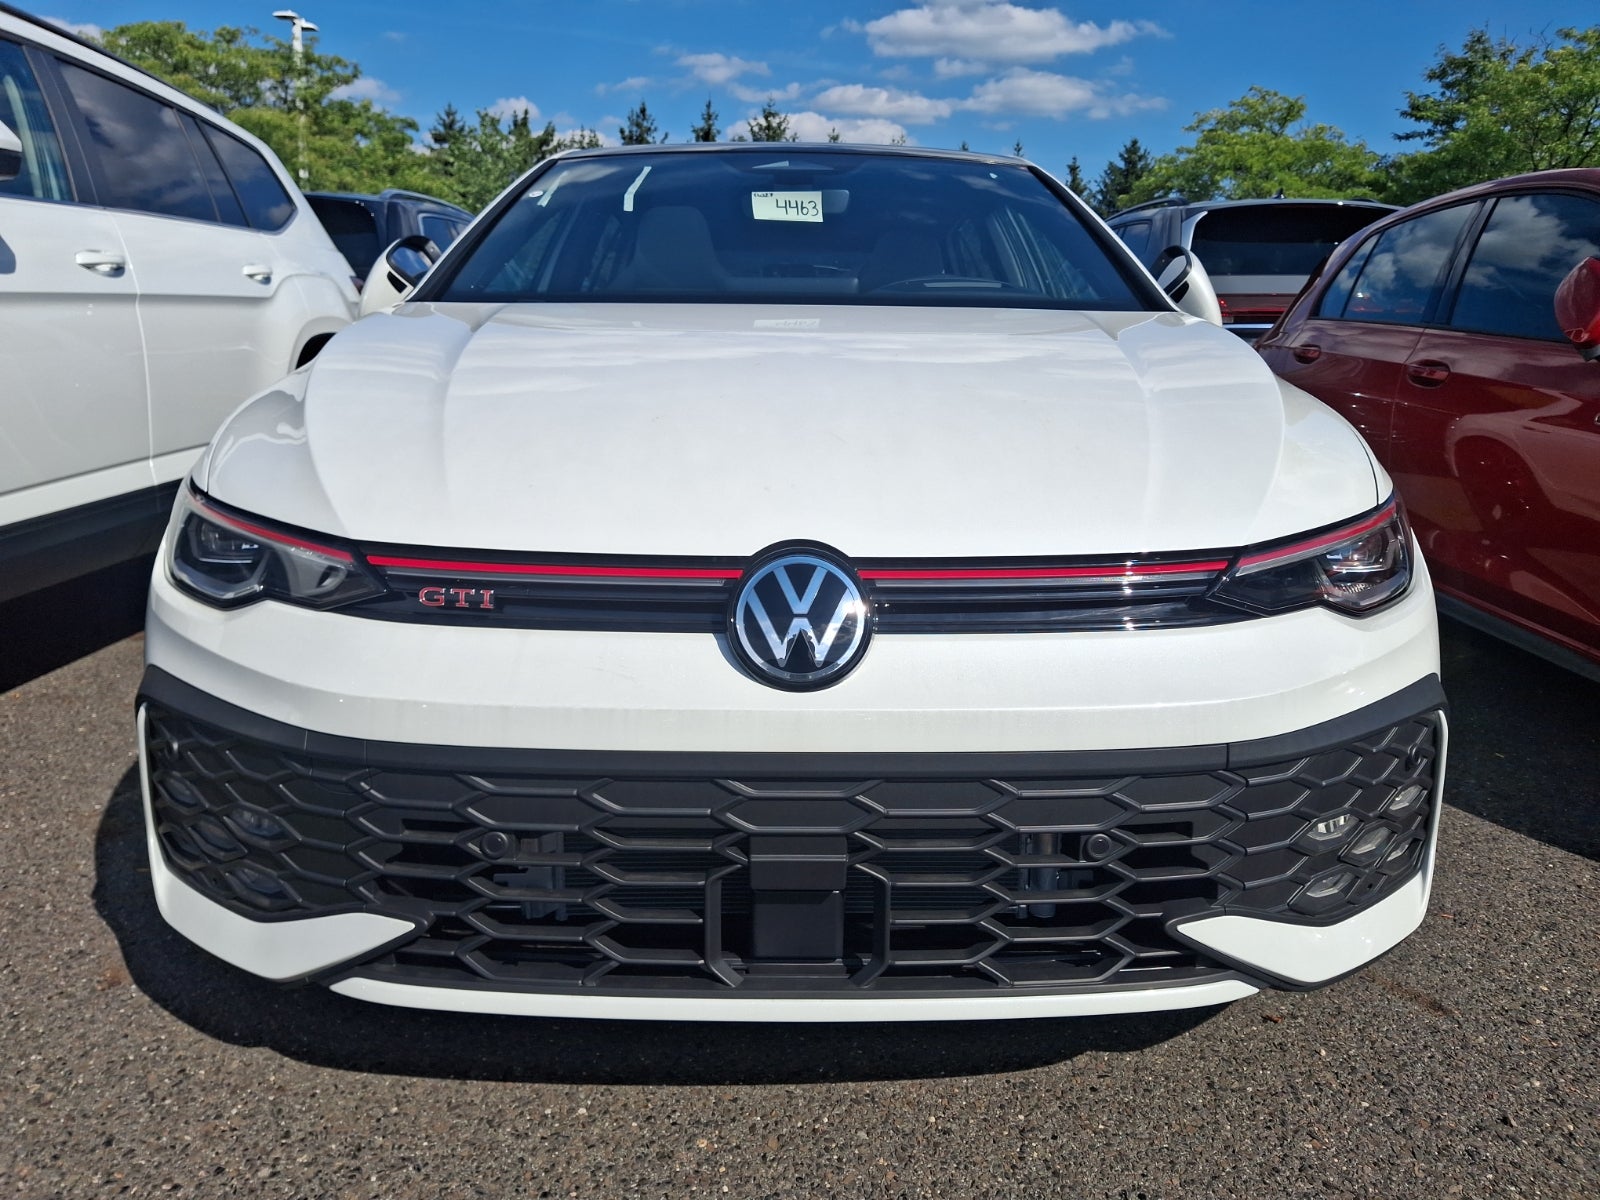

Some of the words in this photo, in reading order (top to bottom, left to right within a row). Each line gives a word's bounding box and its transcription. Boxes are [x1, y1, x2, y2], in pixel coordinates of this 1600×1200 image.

[776, 198, 819, 217] 4463
[418, 586, 495, 609] GTI
[745, 562, 853, 670] VW
